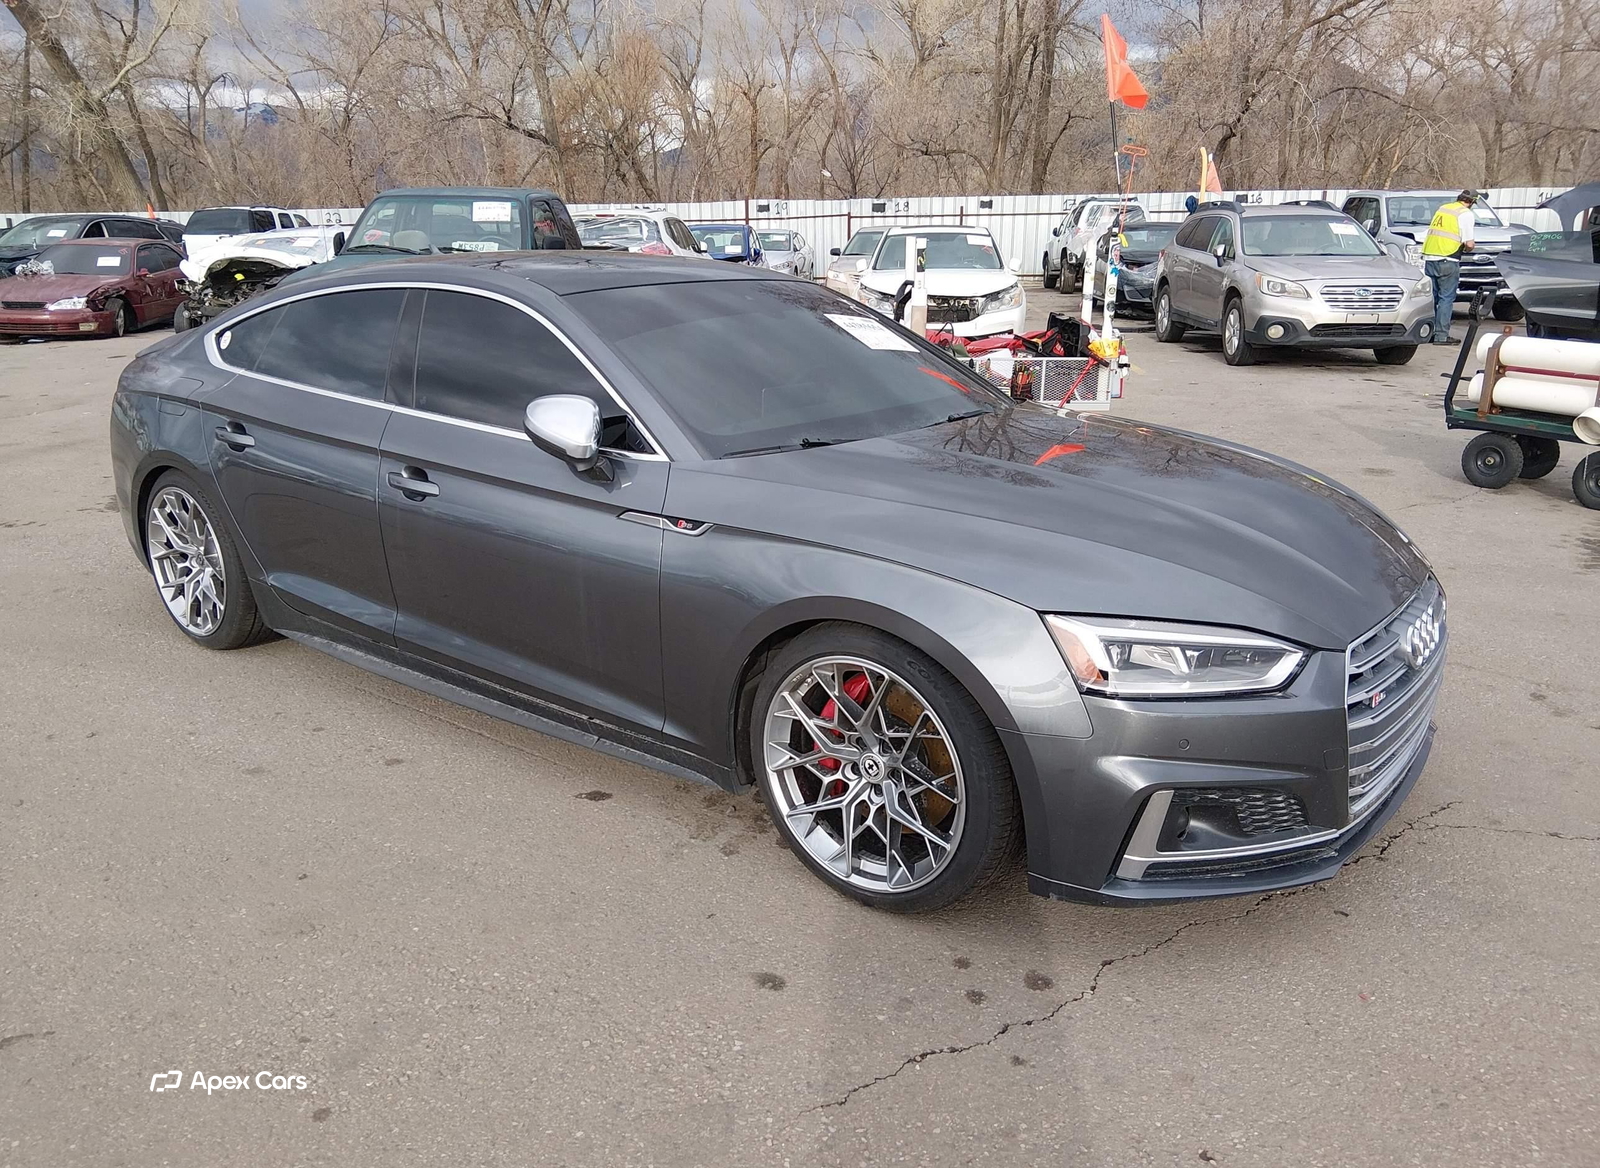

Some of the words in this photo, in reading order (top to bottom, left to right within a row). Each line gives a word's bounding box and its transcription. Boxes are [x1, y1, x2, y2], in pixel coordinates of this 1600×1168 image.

[1250, 193, 1263, 204] 16
[774, 202, 789, 215] 19
[894, 201, 910, 213] 18
[1063, 199, 1077, 211] 17
[325, 212, 342, 224] 22
